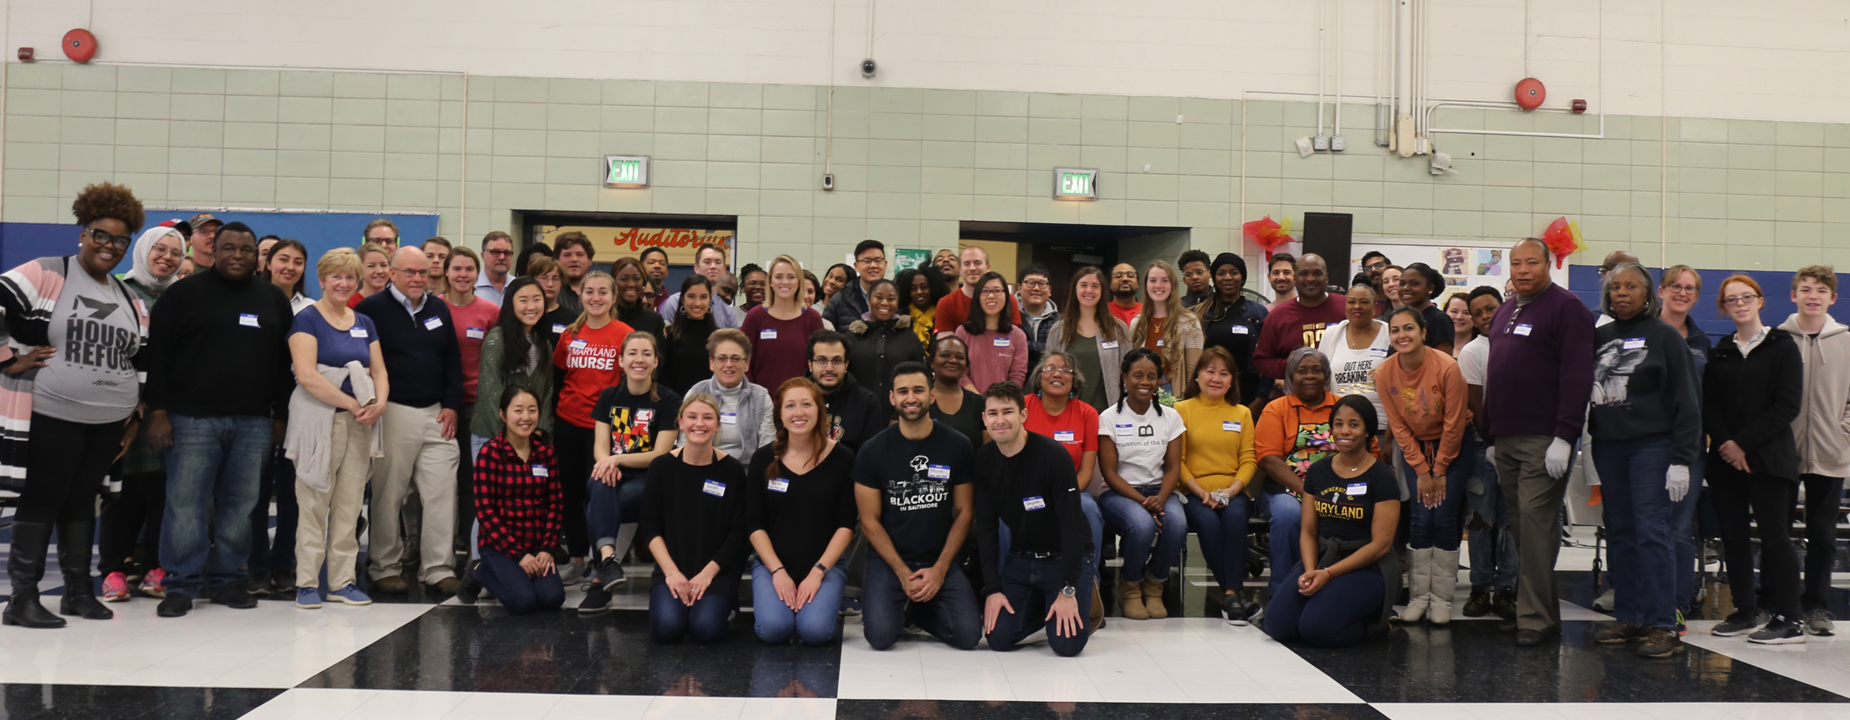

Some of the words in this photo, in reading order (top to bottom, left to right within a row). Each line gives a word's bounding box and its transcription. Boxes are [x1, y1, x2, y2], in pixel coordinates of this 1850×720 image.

[612, 160, 641, 182] EXIT
[1062, 172, 1091, 194] EXIT
[67, 318, 137, 351] HOUSE
[572, 346, 616, 358] MARYLAND
[571, 356, 615, 370] NURSE
[1344, 361, 1357, 372] OUT
[1357, 360, 1373, 370] HERE
[1335, 370, 1367, 384] BREAKING
[1320, 486, 1347, 496] UNIVERSIT
[890, 492, 949, 506] BLACKOUT
[908, 502, 938, 511] BALTIMORE
